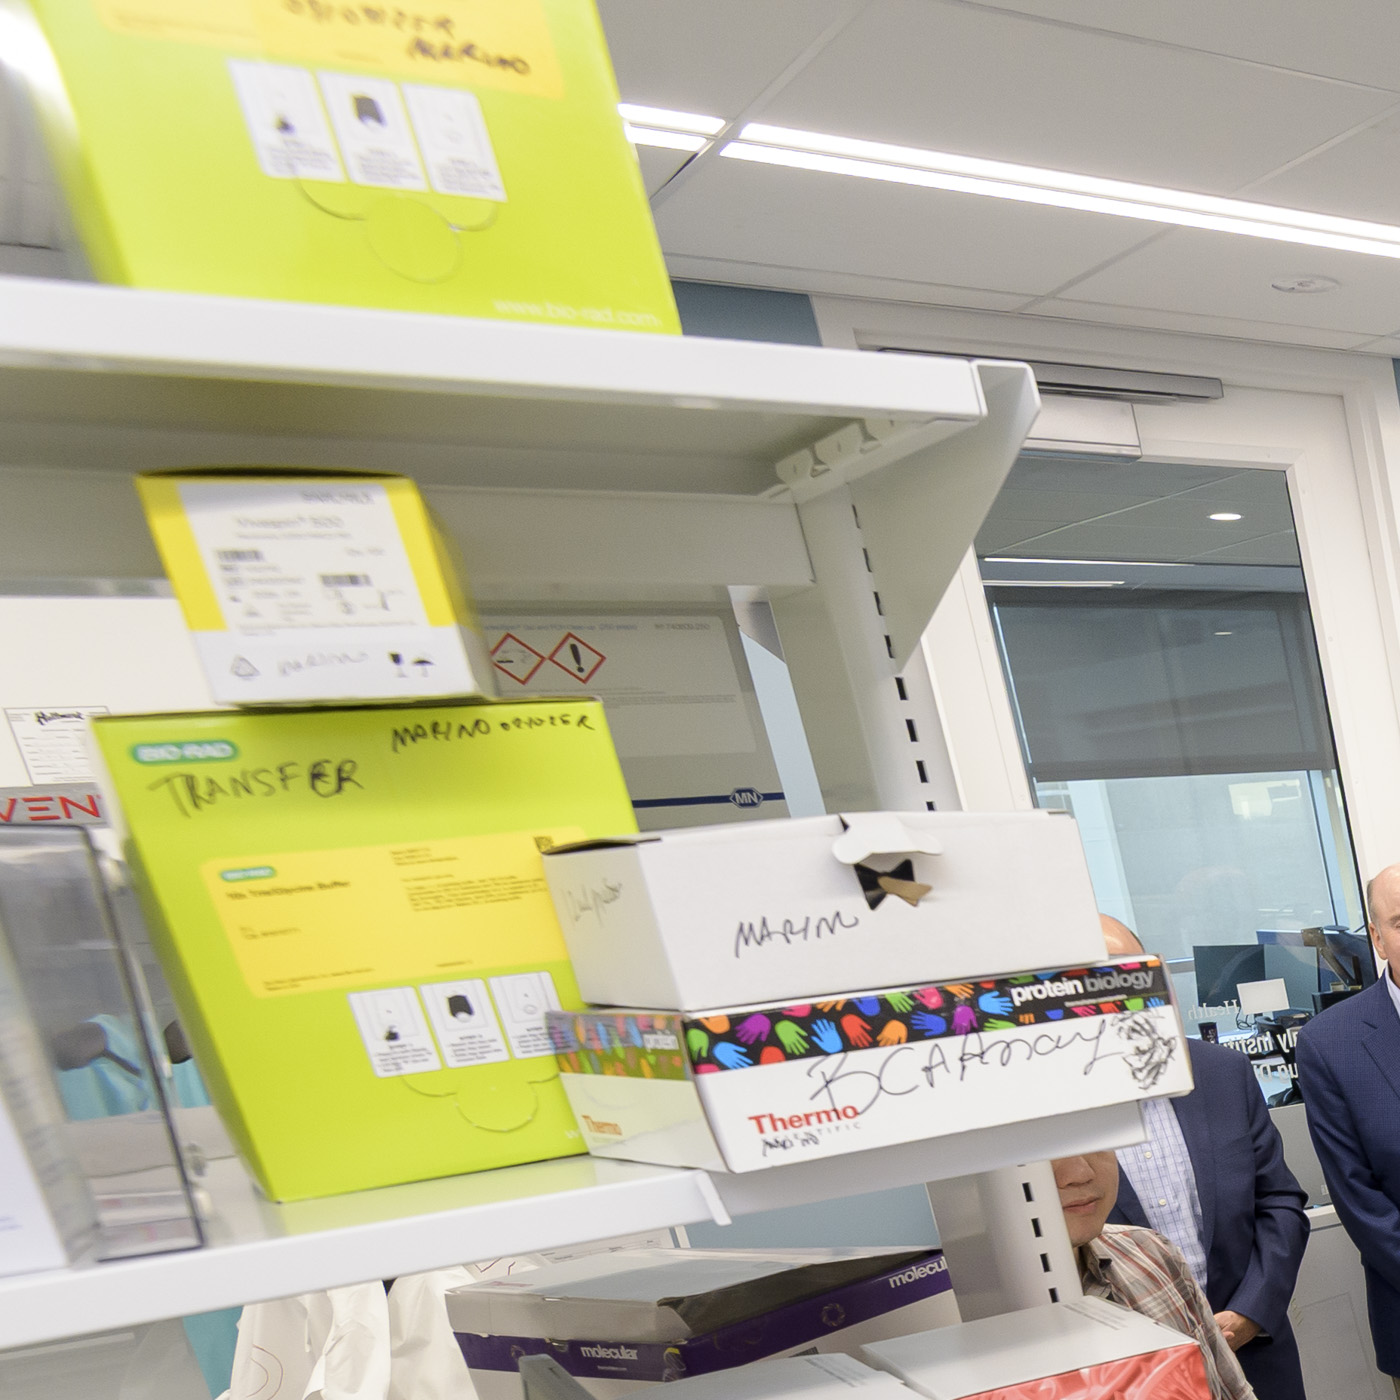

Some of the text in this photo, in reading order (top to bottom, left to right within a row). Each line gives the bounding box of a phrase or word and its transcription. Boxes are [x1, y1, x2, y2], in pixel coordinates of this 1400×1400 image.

[146, 758, 365, 820] TRANSFER
[734, 790, 759, 805] MN
[1010, 977, 1085, 1007] protein
[1084, 969, 1154, 993] biology
[748, 1105, 860, 1134] Thermo
[888, 1256, 948, 1289] molecul
[580, 1344, 638, 1361] molecular
